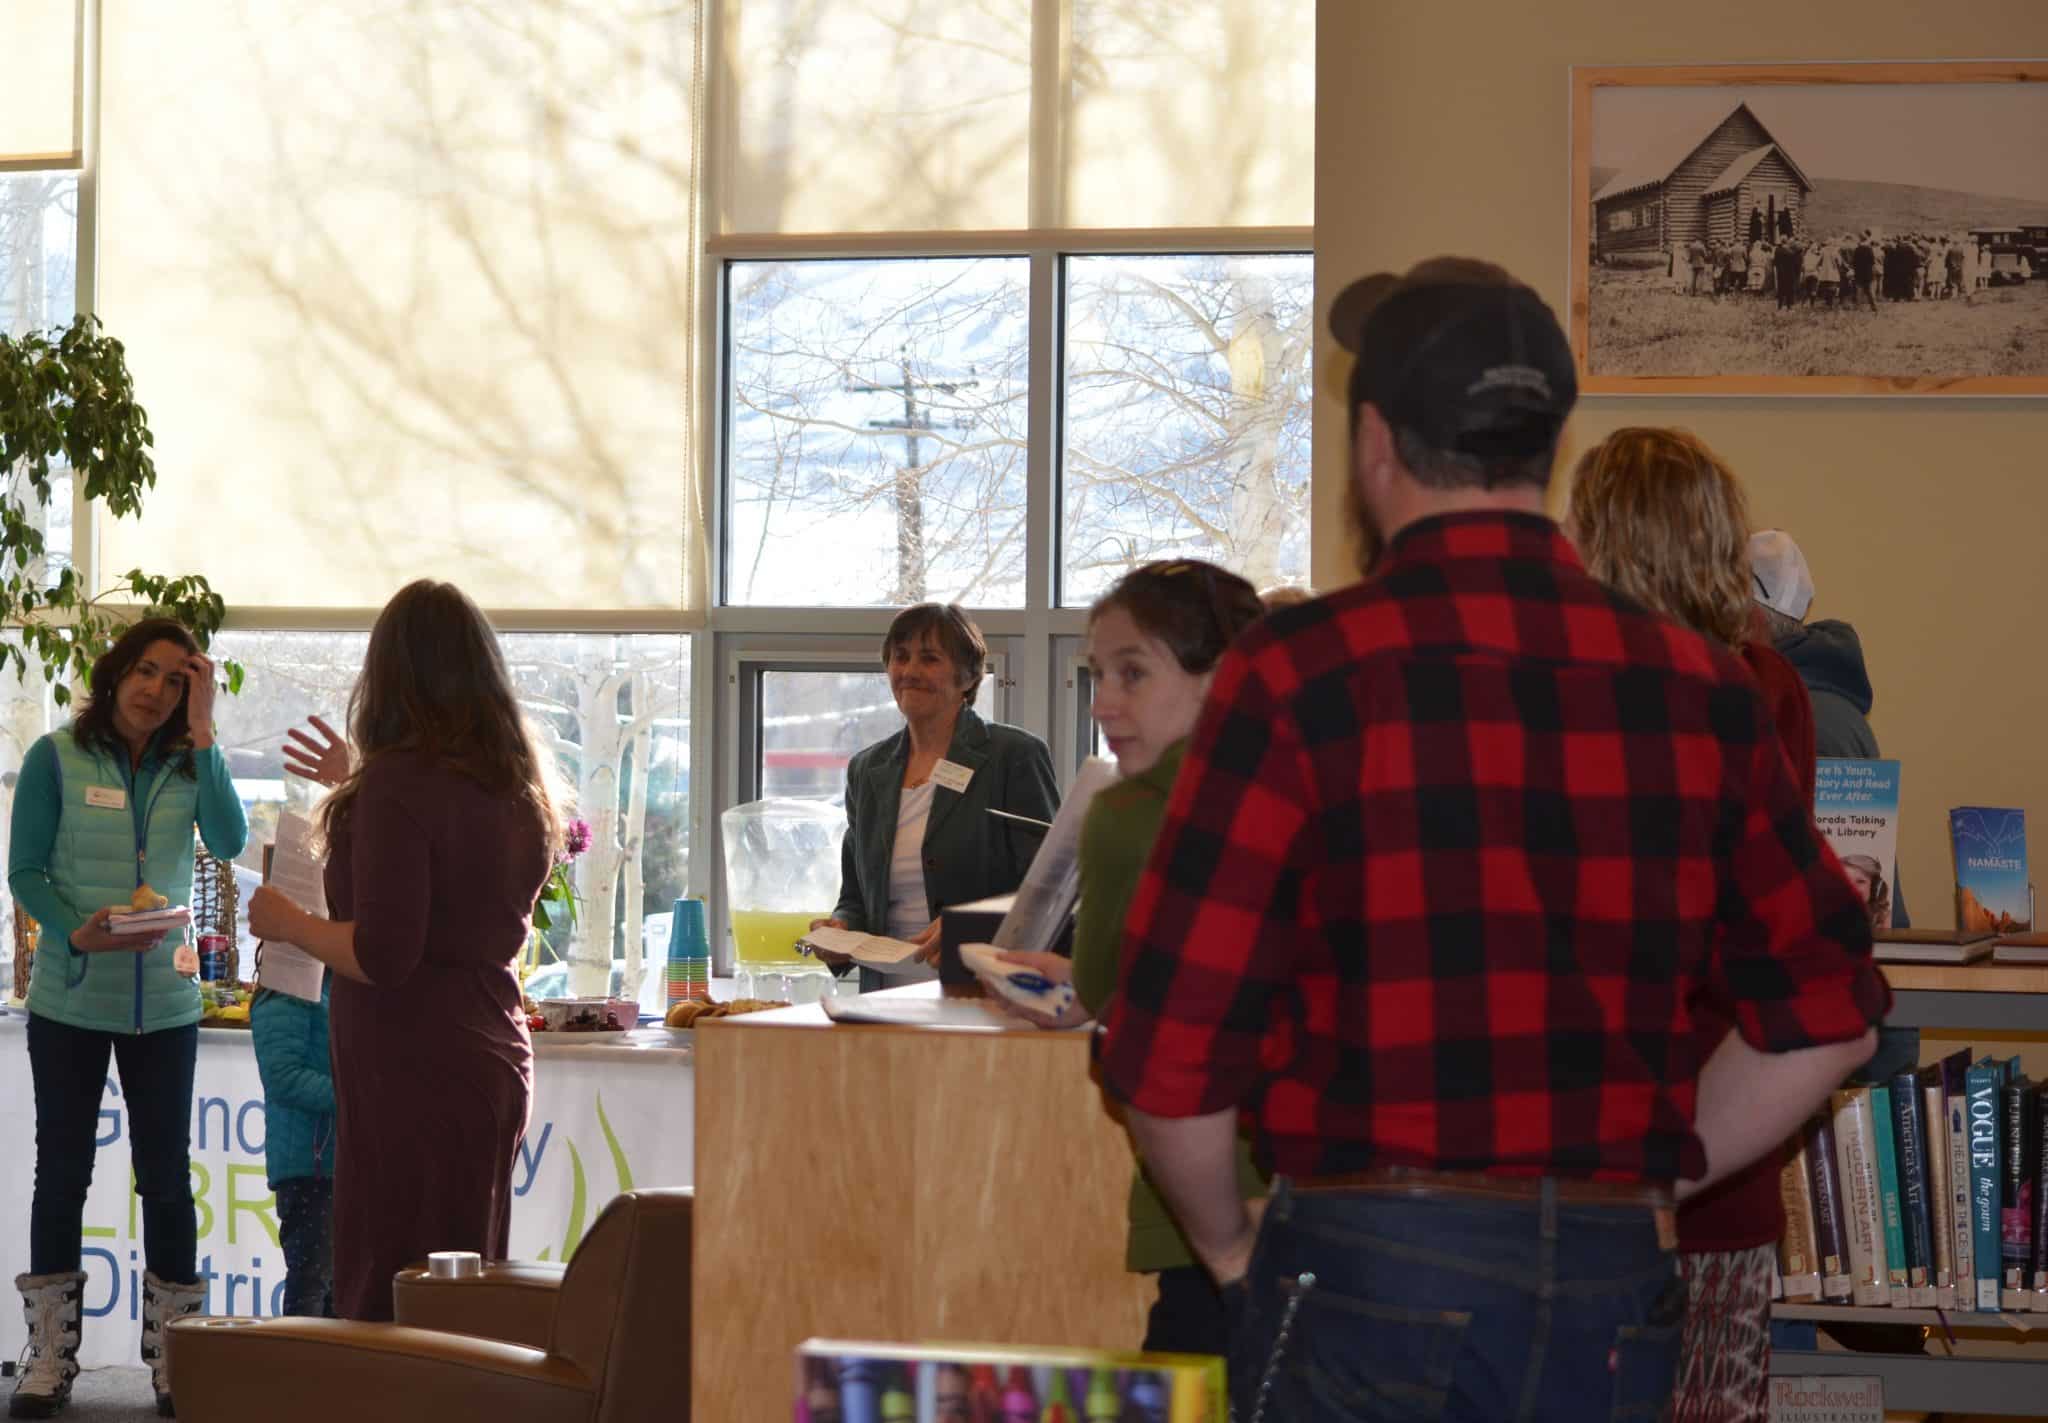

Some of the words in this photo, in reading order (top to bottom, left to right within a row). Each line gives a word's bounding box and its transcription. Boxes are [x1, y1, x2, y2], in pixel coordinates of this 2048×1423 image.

[1838, 827, 1877, 840] Library
[1850, 815, 1886, 828] Talking
[1968, 857, 2022, 871] NAMASTE
[1900, 1103, 1920, 1175] America's
[1971, 1087, 1996, 1168] VOGUE
[1906, 1179, 1922, 1205] Art
[1980, 1177, 1994, 1197] the
[1975, 1198, 1991, 1231] gown
[1860, 1219, 1873, 1255] ART
[1775, 1382, 1880, 1408] Rockwell
